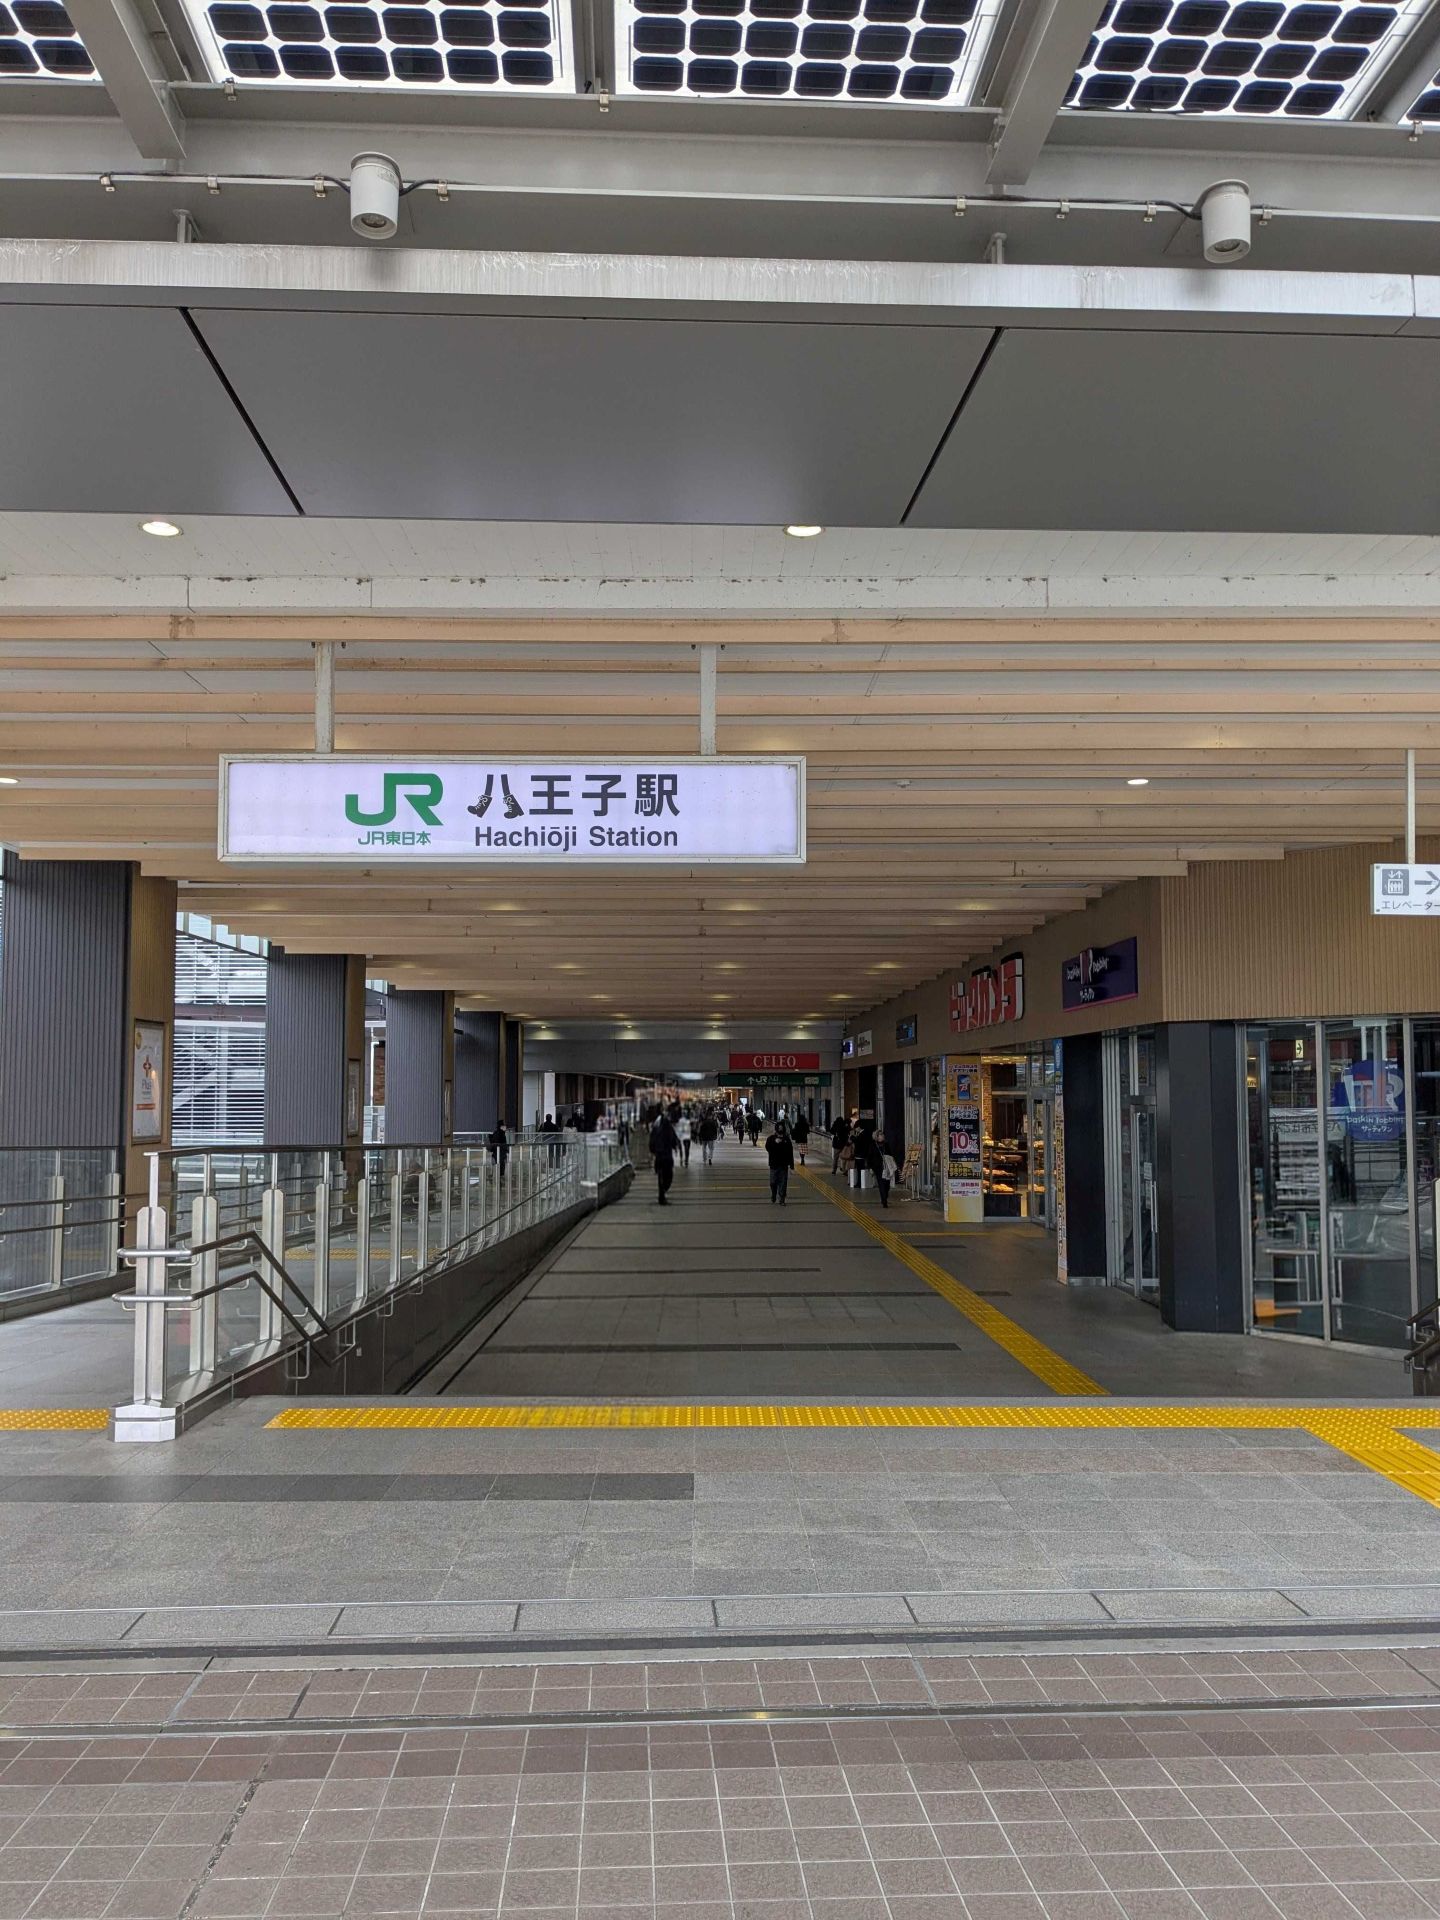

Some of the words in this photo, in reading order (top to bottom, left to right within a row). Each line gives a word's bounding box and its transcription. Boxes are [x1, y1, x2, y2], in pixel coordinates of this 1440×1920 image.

[345, 773, 444, 826] JR
[467, 773, 680, 819] 八王子駅
[357, 830, 432, 846] JR東日本
[474, 826, 577, 852] Hachiōji
[589, 826, 679, 848] Station
[752, 1055, 797, 1068] CELEO
